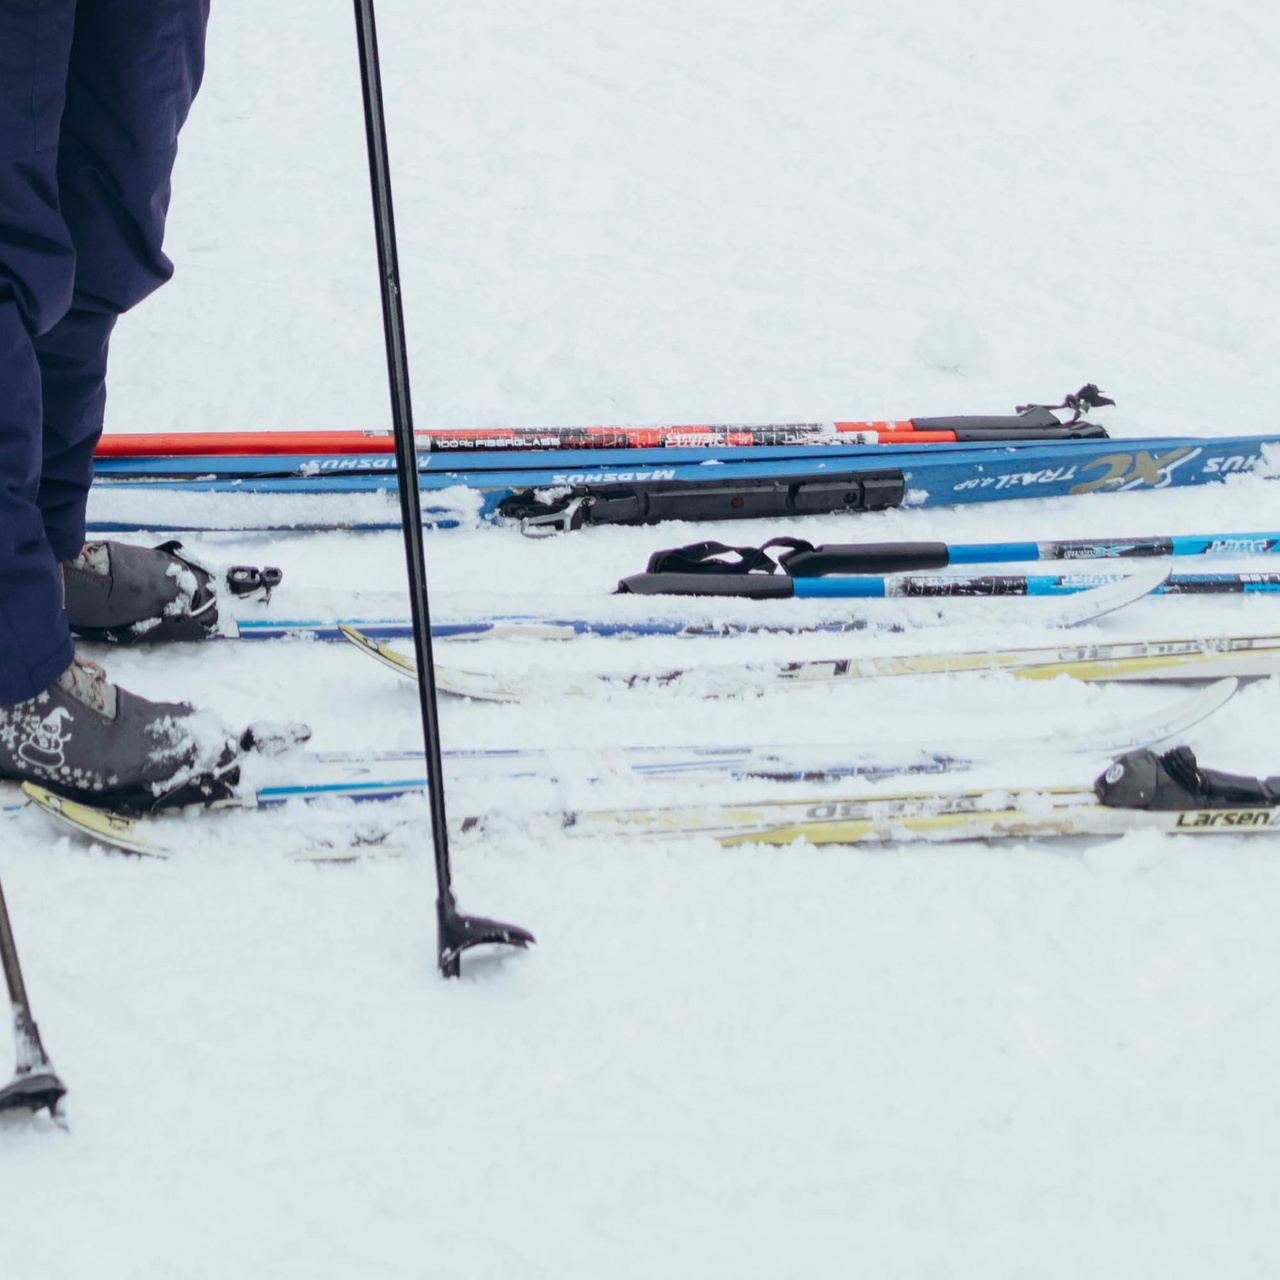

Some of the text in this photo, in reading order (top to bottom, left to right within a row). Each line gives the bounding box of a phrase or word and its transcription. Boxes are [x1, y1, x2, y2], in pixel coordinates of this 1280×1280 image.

[436, 437, 561, 448] 100% FIBERGLASS
[306, 455, 432, 472] MDSHUS
[551, 469, 676, 484] MADSHUS
[1175, 811, 1271, 828] Larsen
